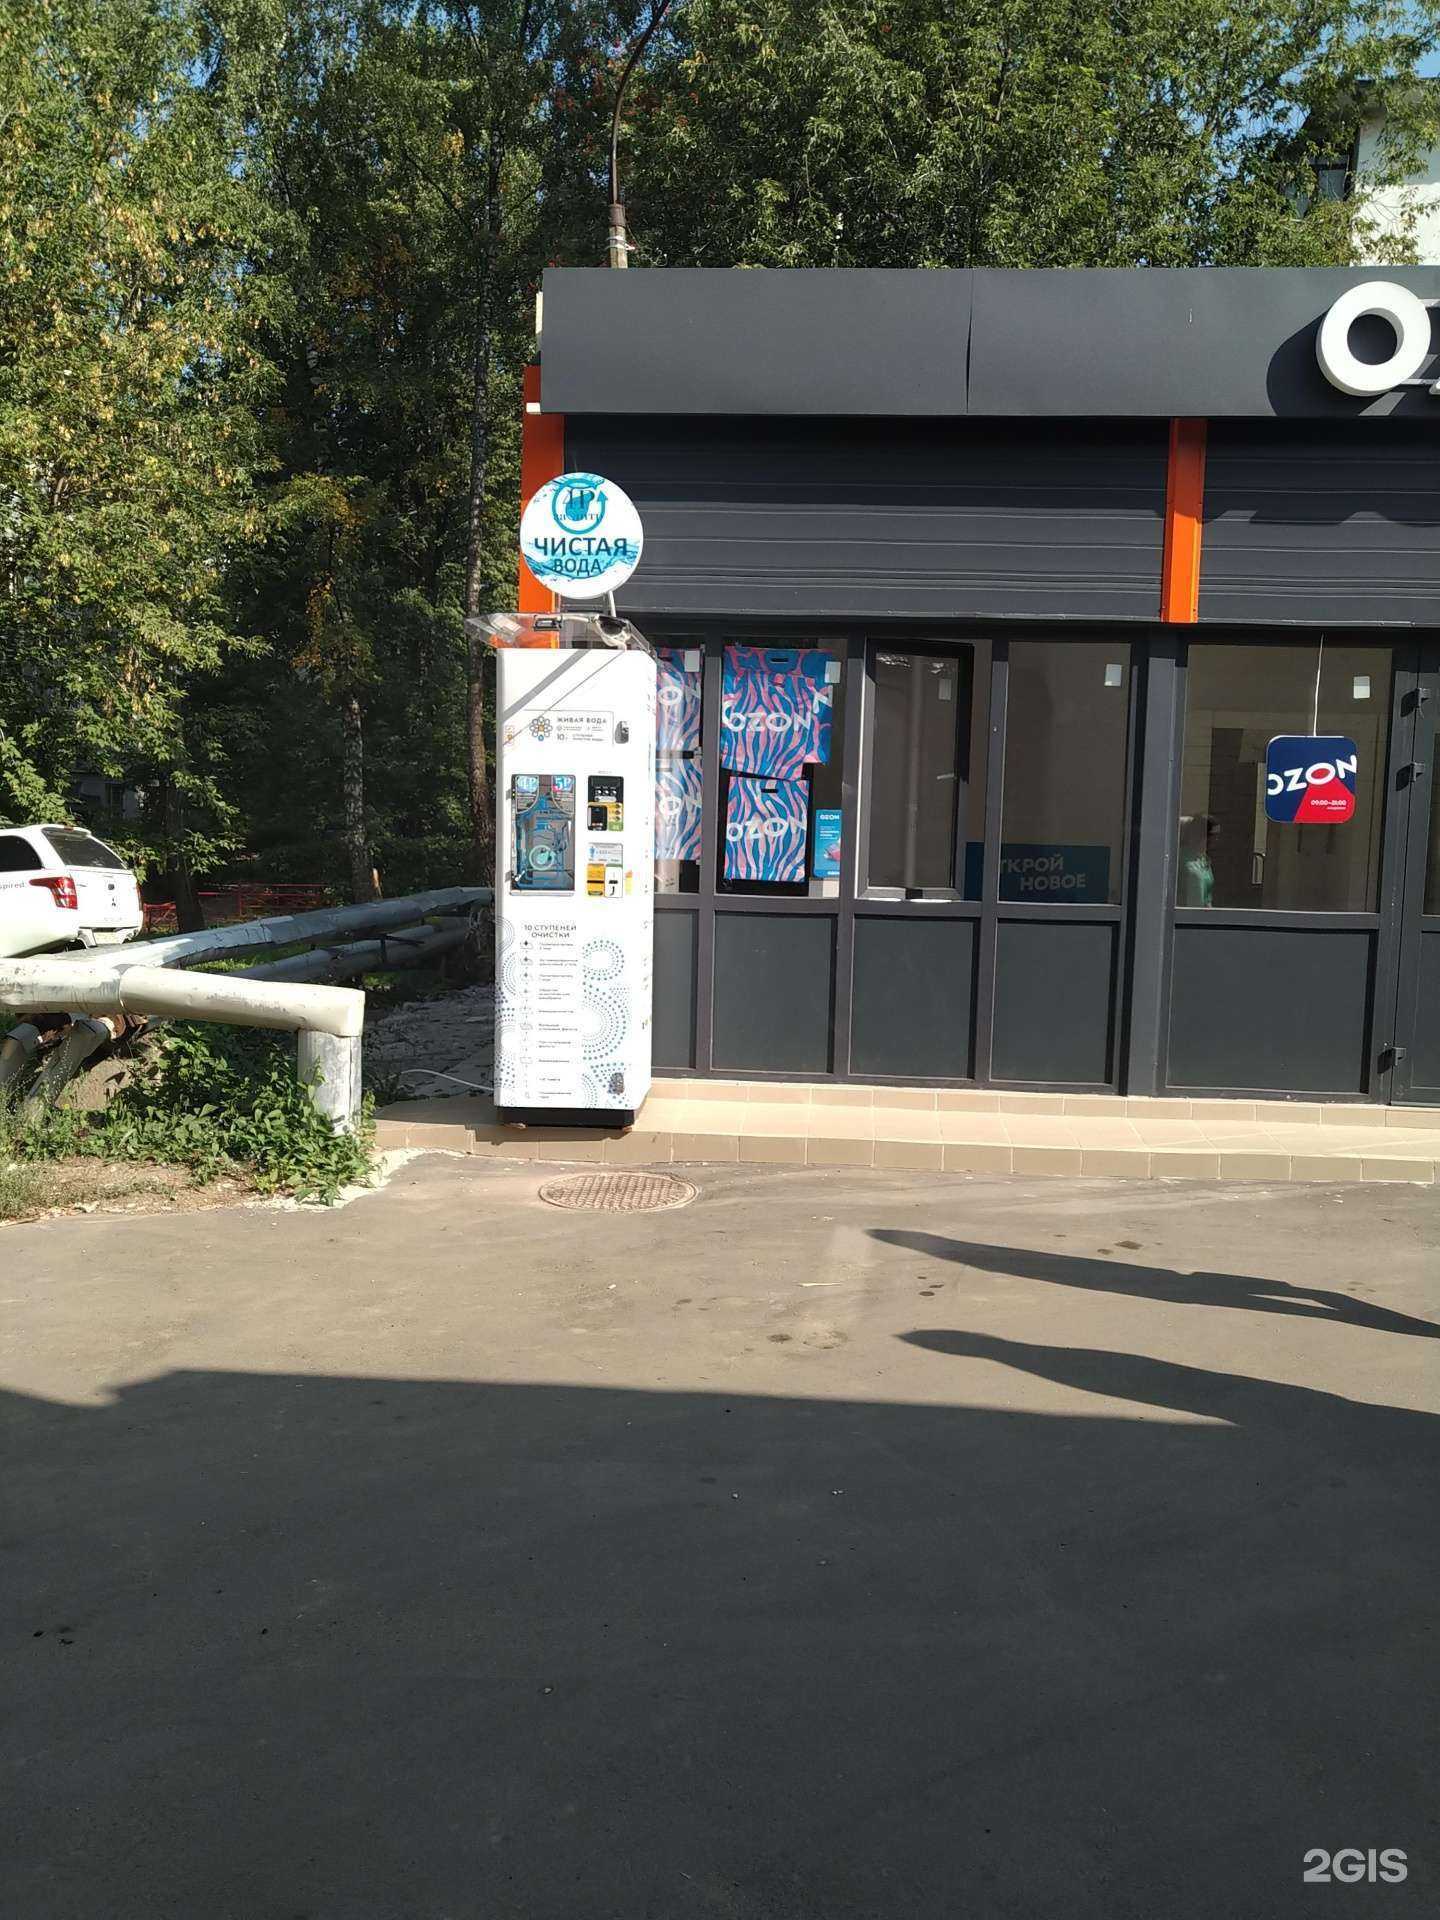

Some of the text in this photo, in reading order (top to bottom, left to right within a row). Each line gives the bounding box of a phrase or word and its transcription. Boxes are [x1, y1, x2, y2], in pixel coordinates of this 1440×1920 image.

[1316, 281, 1440, 397] O
[534, 537, 628, 557] ЧИСТАЯ
[553, 559, 602, 576] ВОДА
[1267, 754, 1358, 796] OZON
[1020, 873, 1087, 891] НОВОЕ
